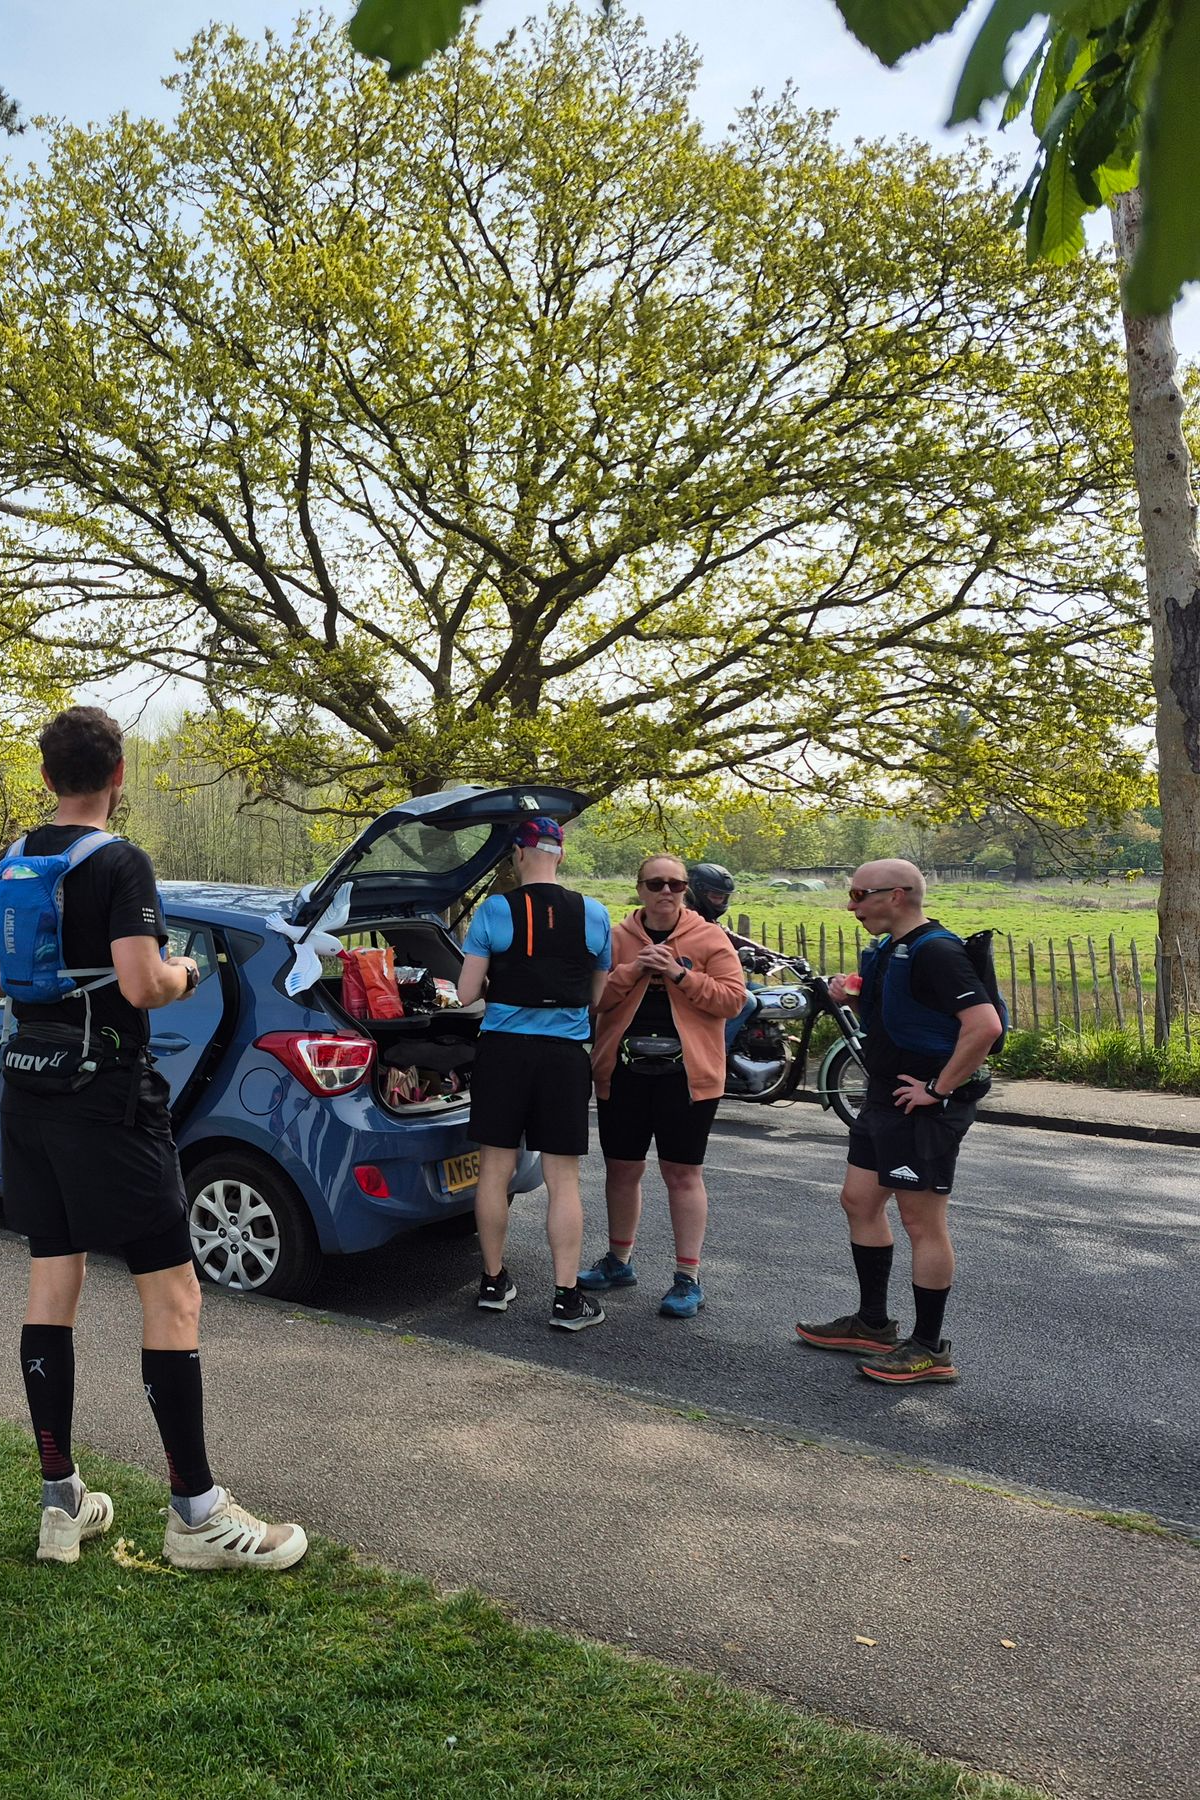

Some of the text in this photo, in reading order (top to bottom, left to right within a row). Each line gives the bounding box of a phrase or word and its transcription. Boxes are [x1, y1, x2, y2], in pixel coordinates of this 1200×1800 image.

[4, 907, 16, 954] CAMELBAK
[448, 1154, 480, 1185] AY66
[910, 1360, 933, 1373] HOKA
